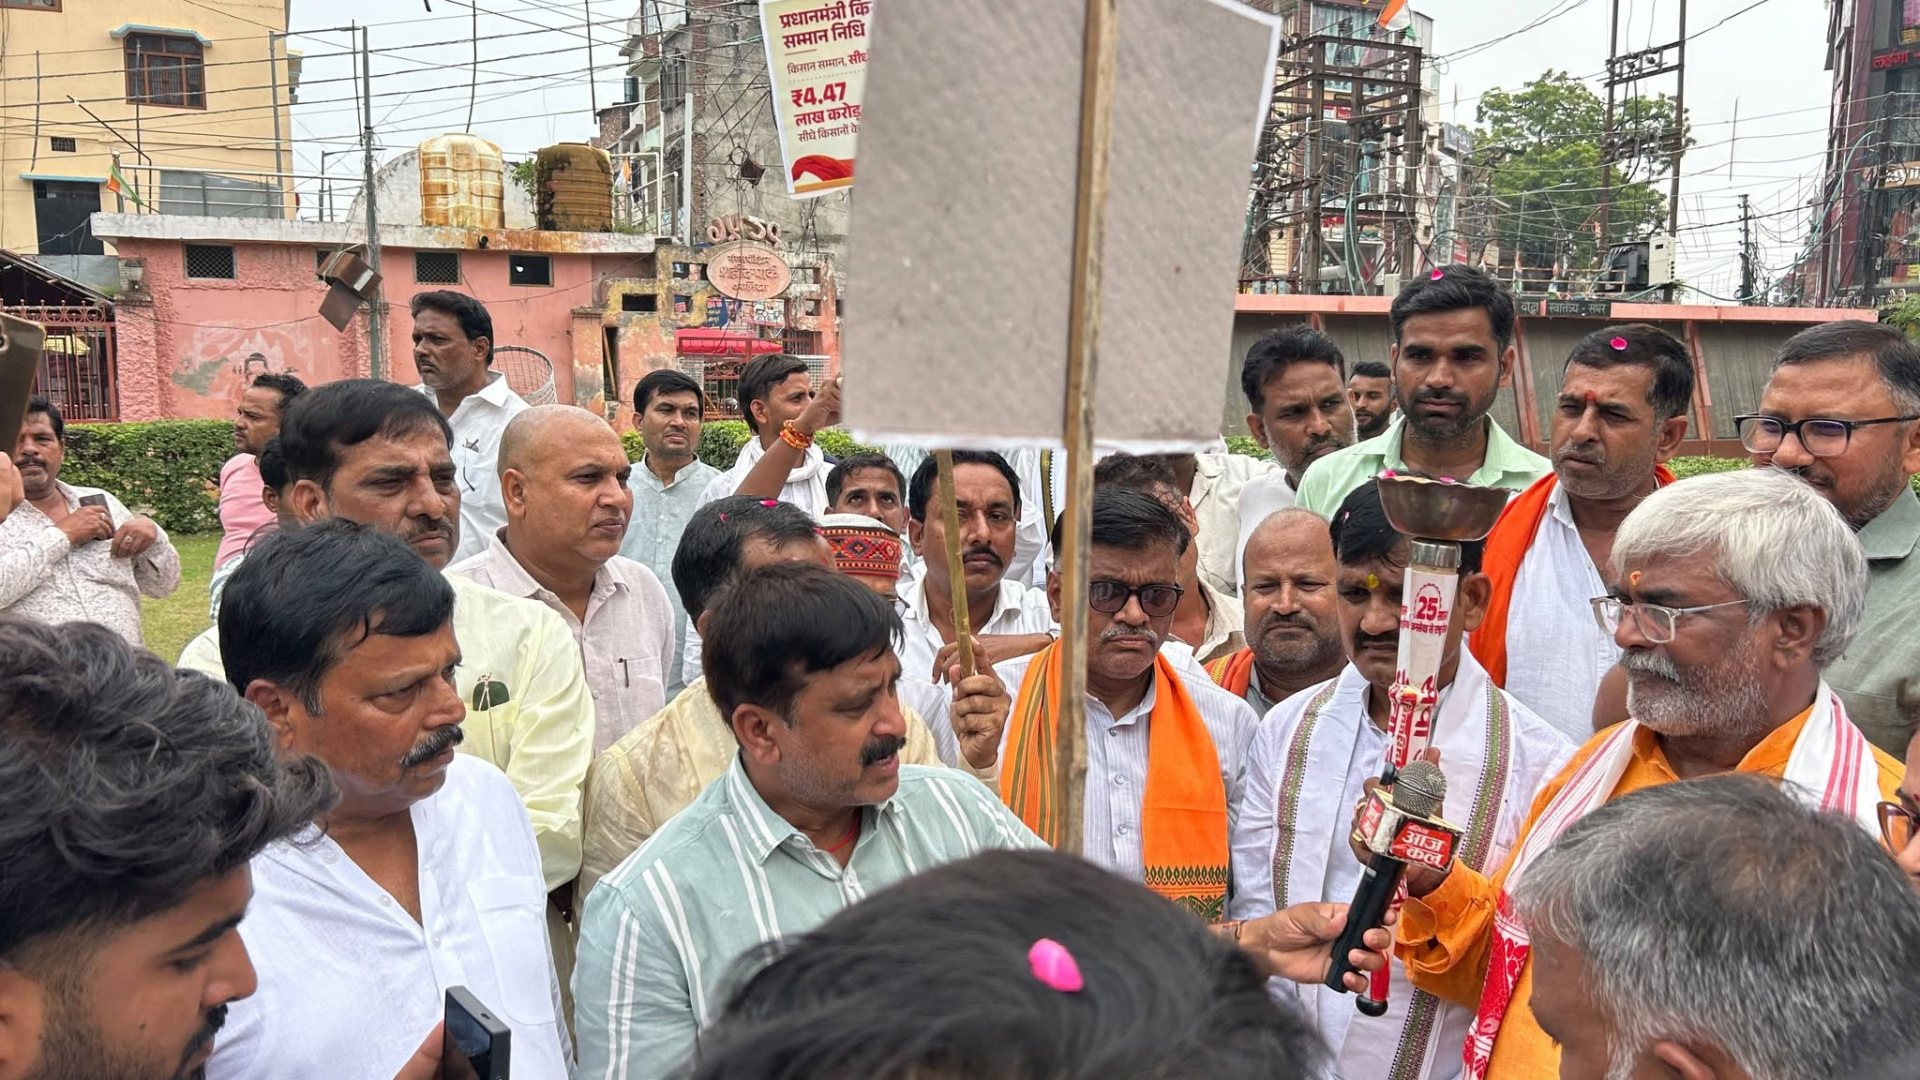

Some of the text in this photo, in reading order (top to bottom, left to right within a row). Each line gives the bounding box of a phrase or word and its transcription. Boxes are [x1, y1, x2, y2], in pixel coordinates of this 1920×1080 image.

[779, 1, 846, 29] प्रधानमंत्री
[783, 20, 865, 49] सम्मान निधि
[787, 60, 816, 75] किसान
[791, 82, 846, 107] ₹4.47
[794, 110, 825, 127] लाख
[798, 128, 816, 143] सीधे
[817, 124, 849, 140] किसानों
[1416, 596, 1438, 620] 25
